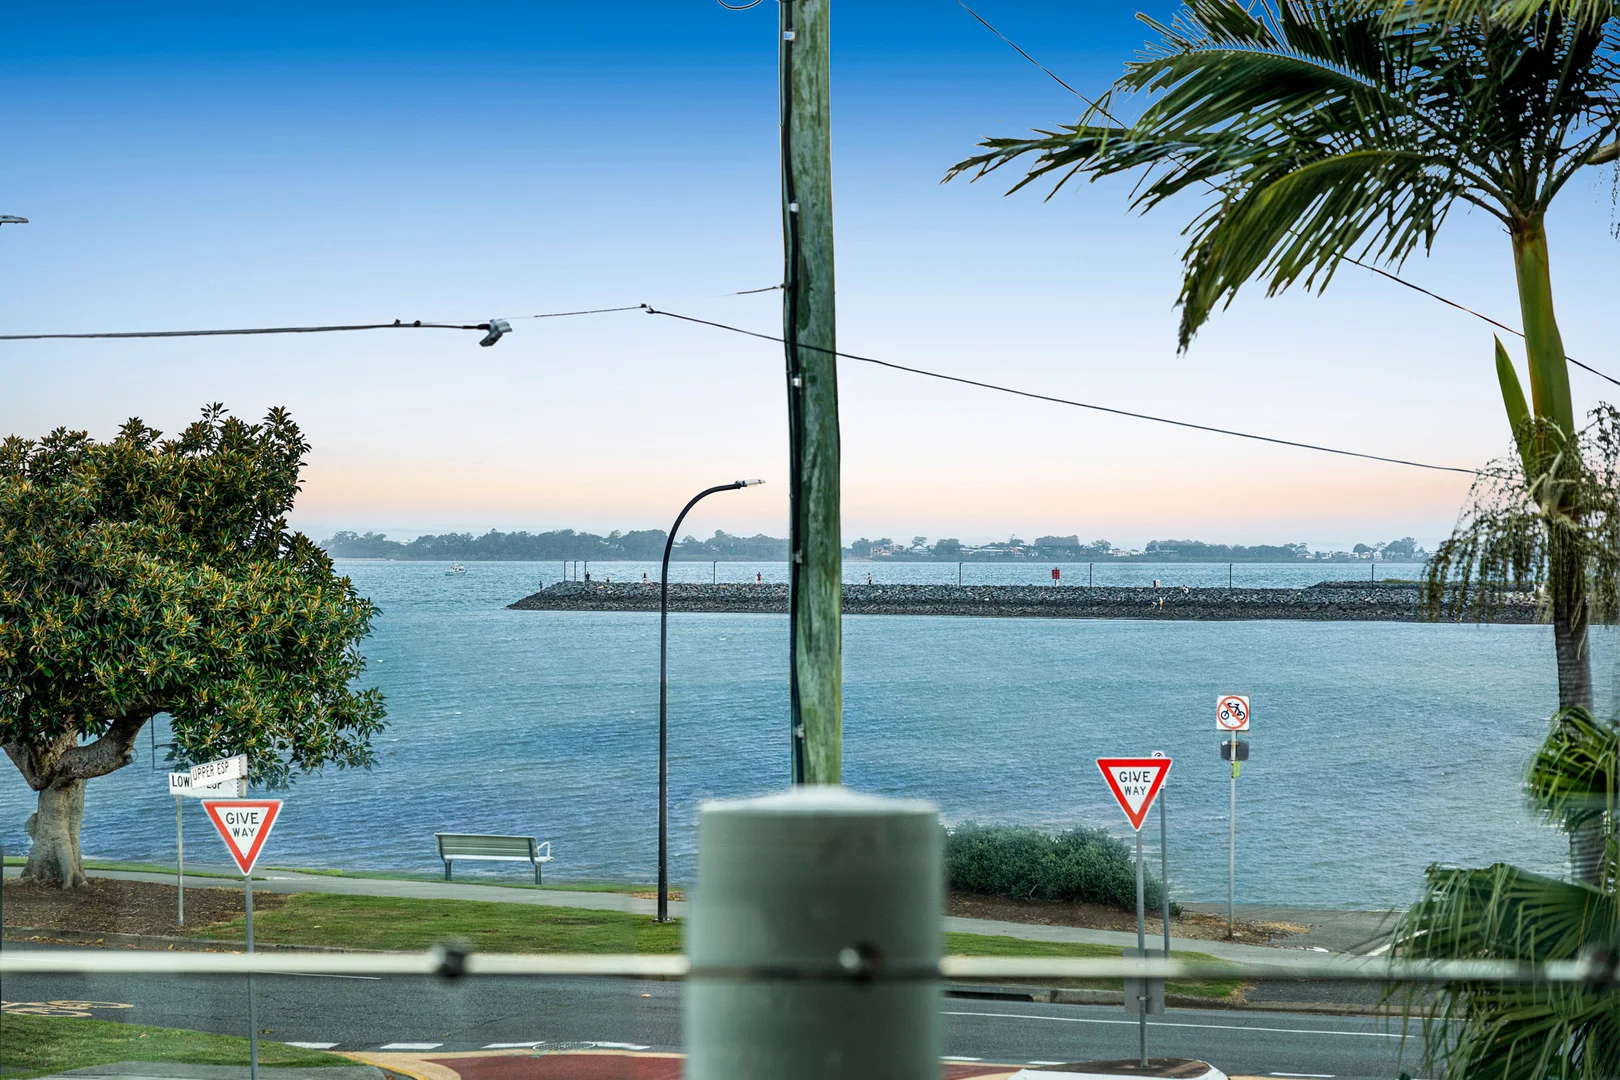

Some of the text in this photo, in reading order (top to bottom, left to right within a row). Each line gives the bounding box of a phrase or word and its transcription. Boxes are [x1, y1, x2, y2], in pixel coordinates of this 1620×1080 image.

[192, 761, 229, 781] UPPER ESP
[1119, 771, 1151, 783] GIVE
[171, 774, 193, 788] LOW
[1124, 786, 1147, 796] WAY
[225, 812, 260, 825] GIVE
[232, 827, 255, 837] WAY
